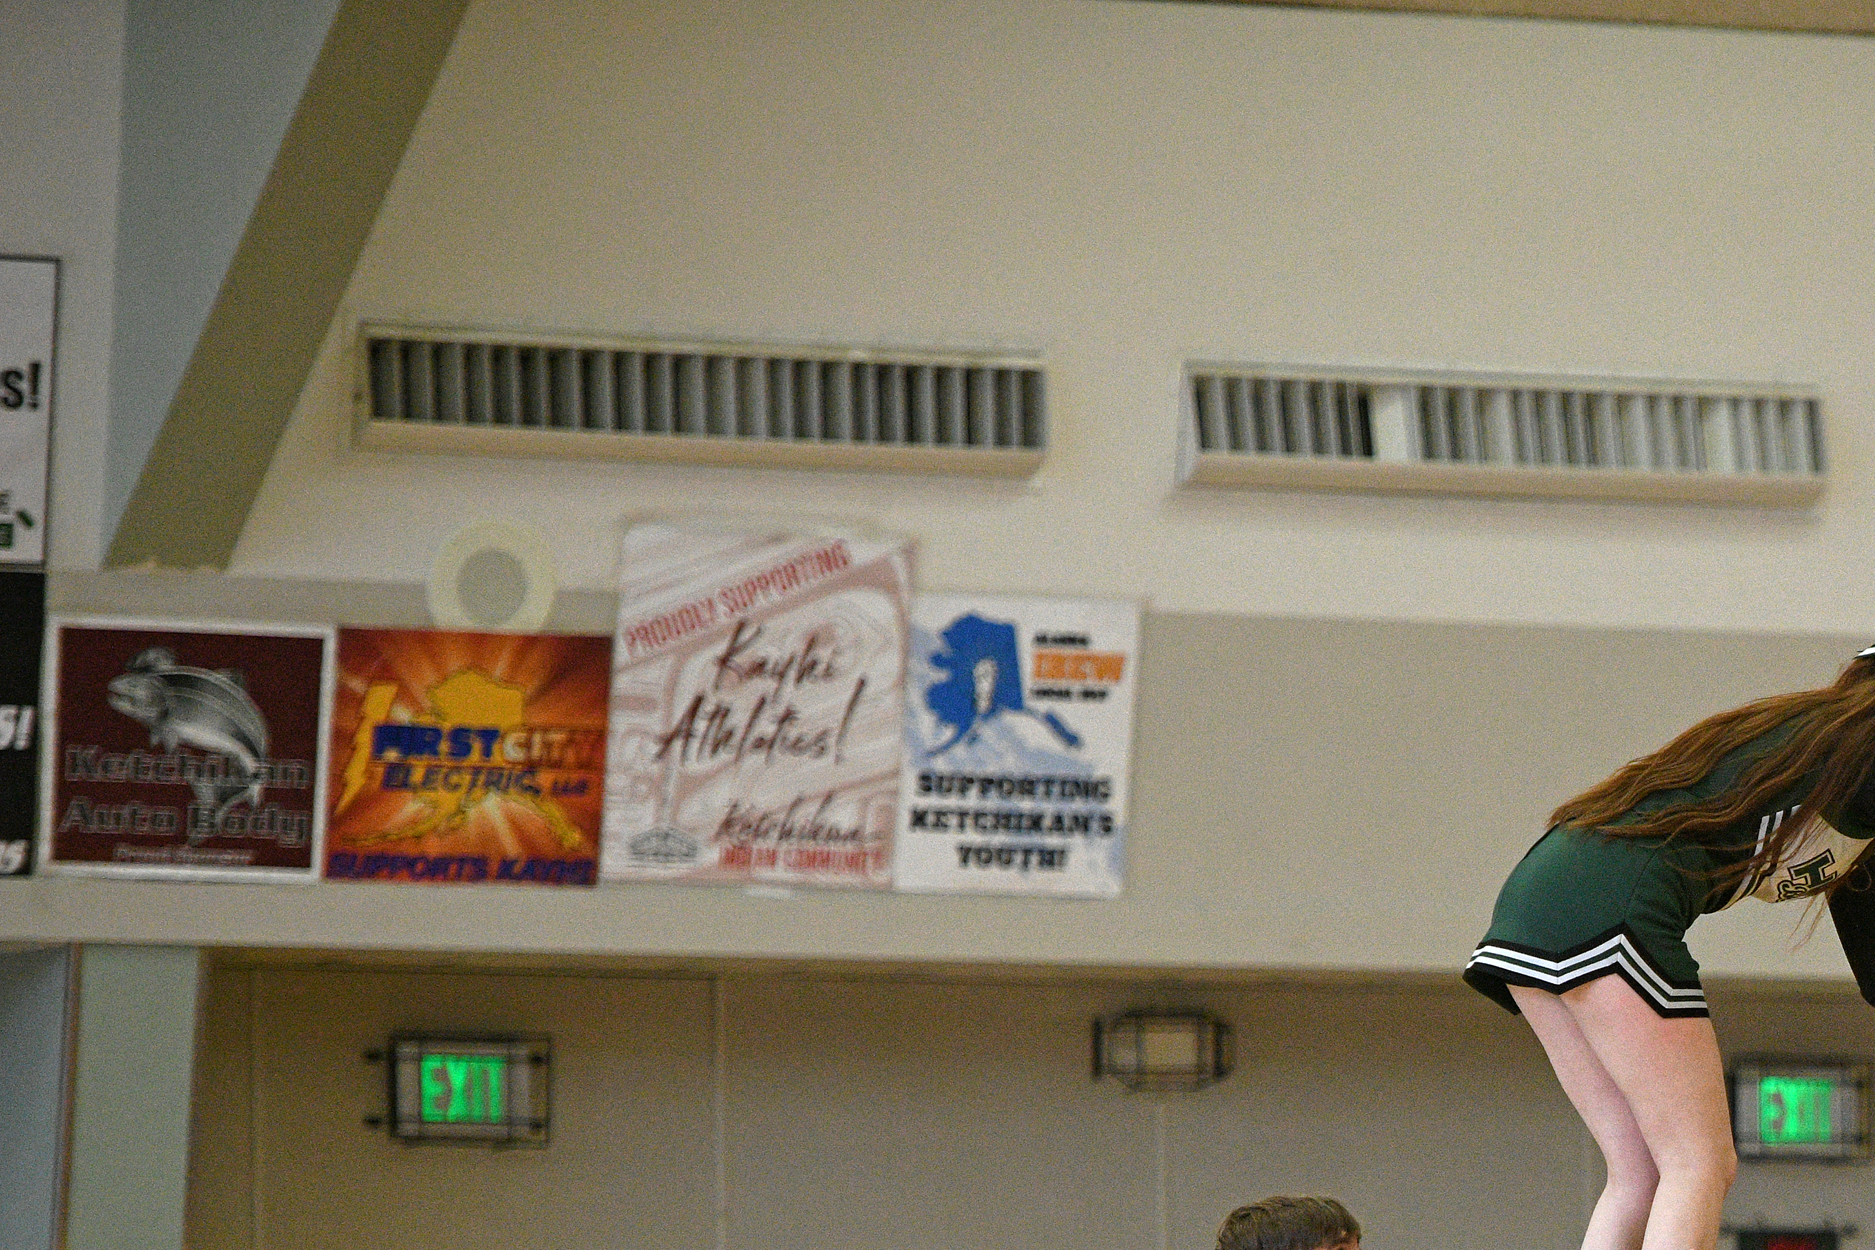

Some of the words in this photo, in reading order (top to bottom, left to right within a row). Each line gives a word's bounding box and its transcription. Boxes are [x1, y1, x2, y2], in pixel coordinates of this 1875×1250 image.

[718, 539, 853, 617] SUPPORTING
[916, 773, 1113, 801] SUPPORTING
[57, 795, 180, 836] Auto
[186, 802, 313, 849] Body
[909, 807, 1115, 837] KETCHIKAN'S
[955, 844, 1070, 874] YOUTH!
[421, 1054, 508, 1124] EXIT
